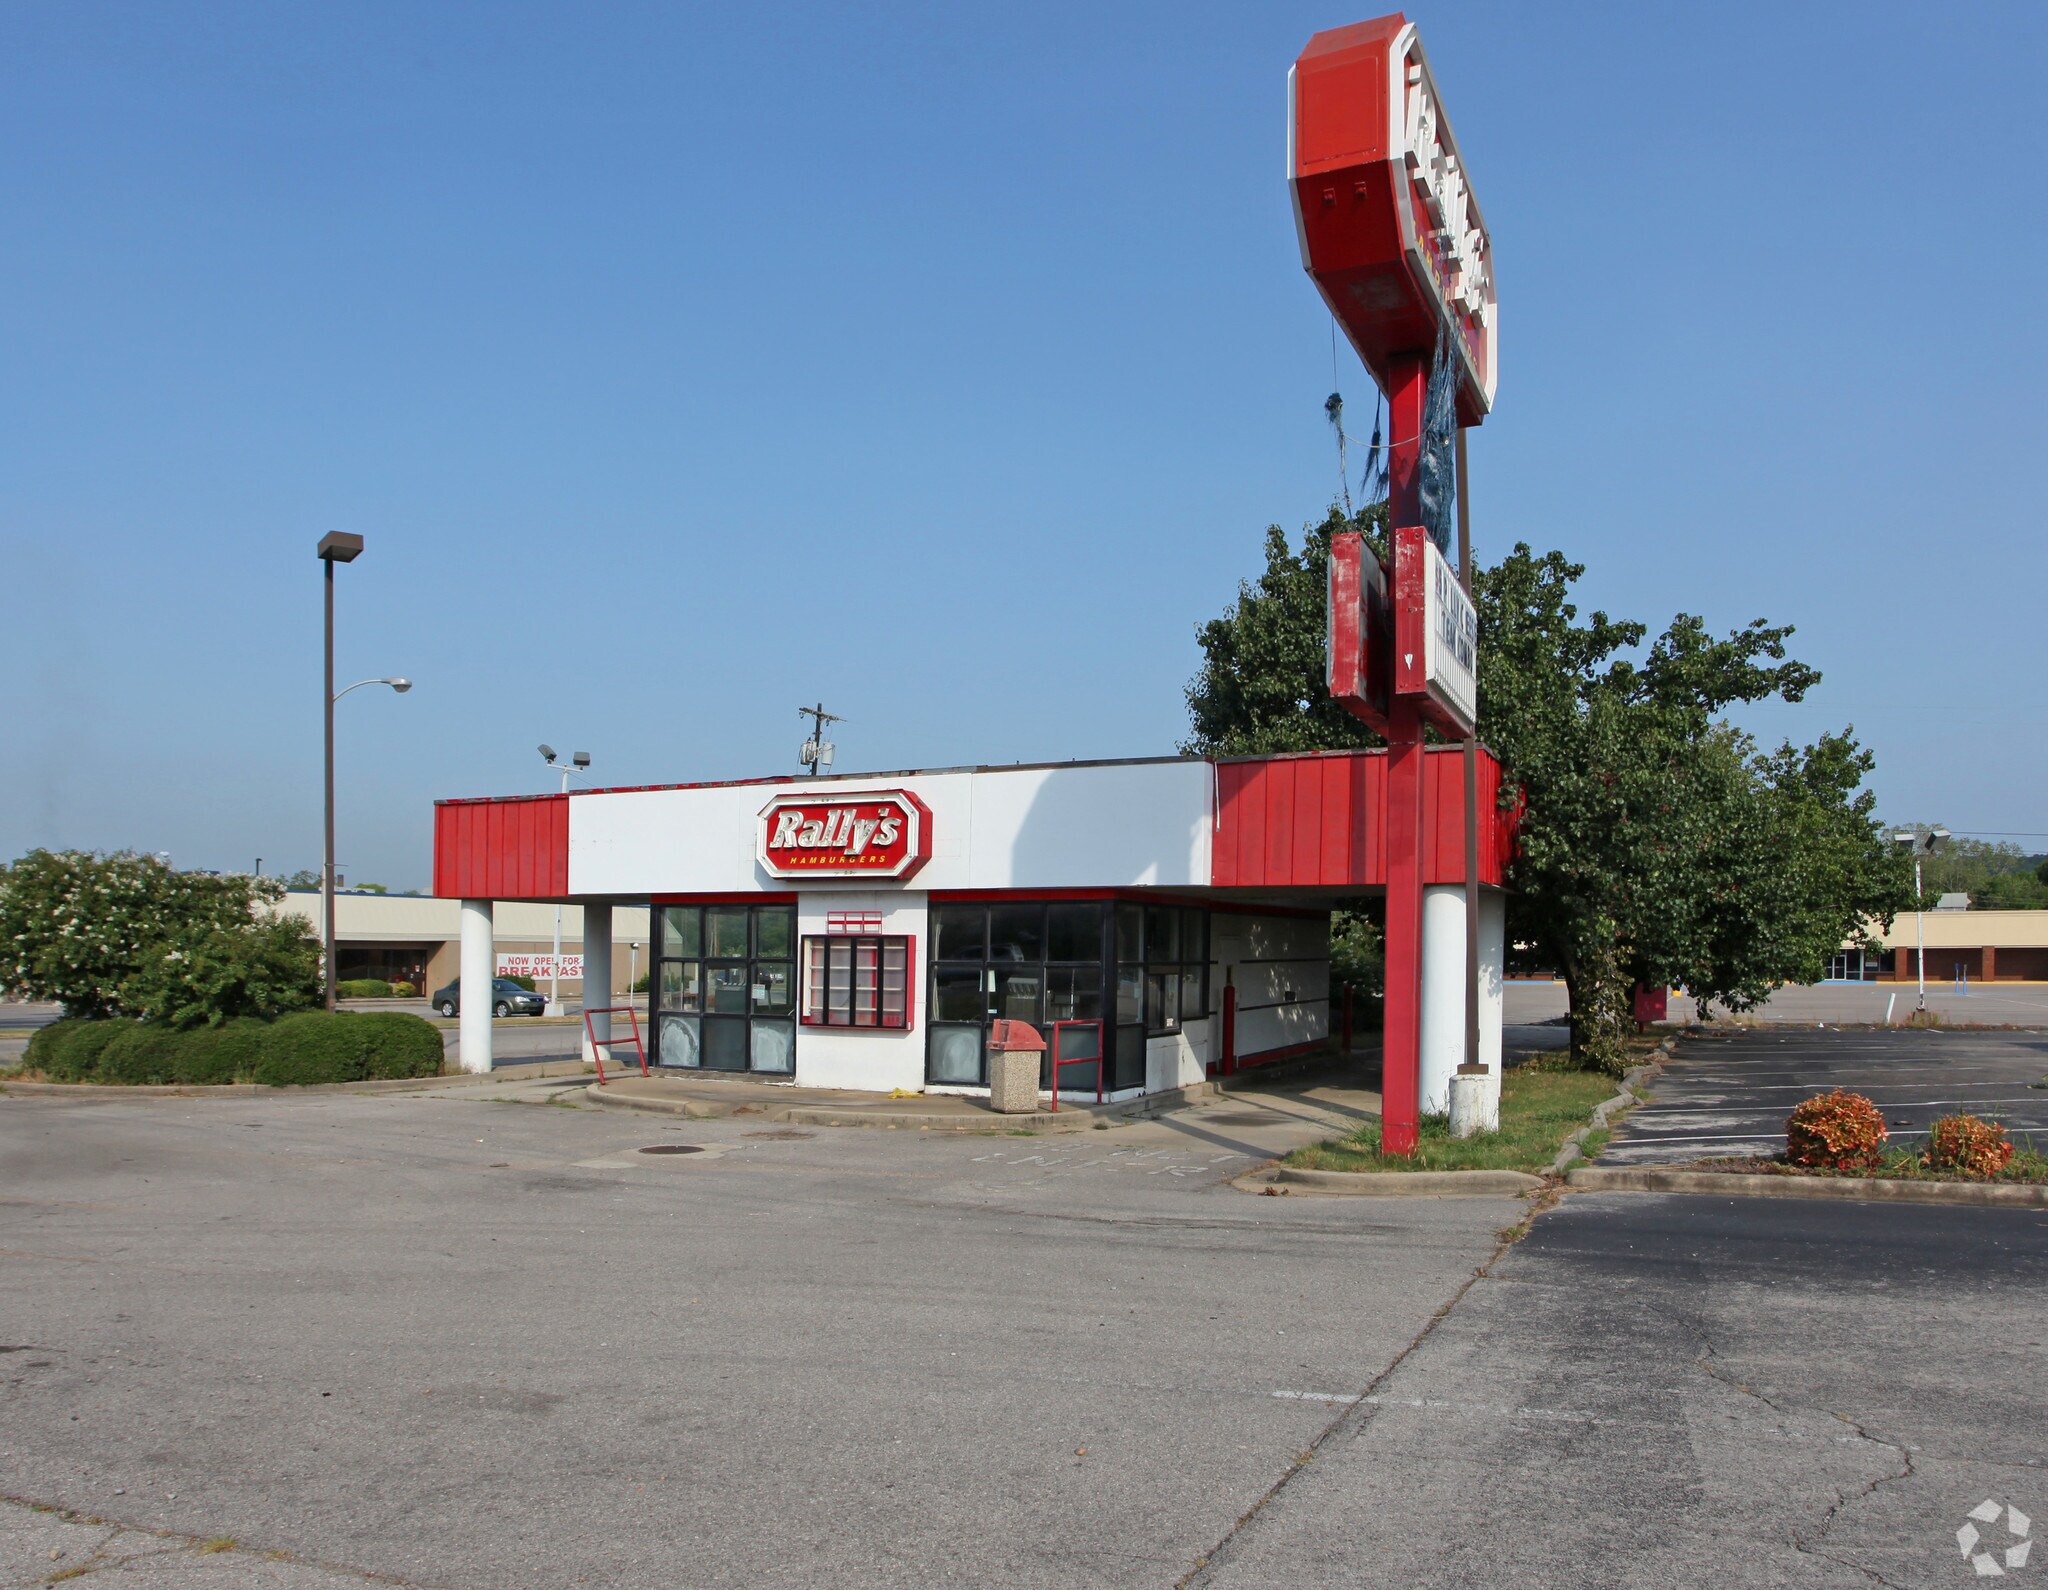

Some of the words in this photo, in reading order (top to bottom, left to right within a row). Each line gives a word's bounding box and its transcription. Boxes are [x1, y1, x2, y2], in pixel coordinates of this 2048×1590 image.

[770, 807, 902, 855] Rally's
[790, 855, 886, 864] HAMBURGERS
[508, 957, 529, 965] NOW
[563, 957, 580, 965] FOR
[498, 966, 585, 977] BREAKAST
